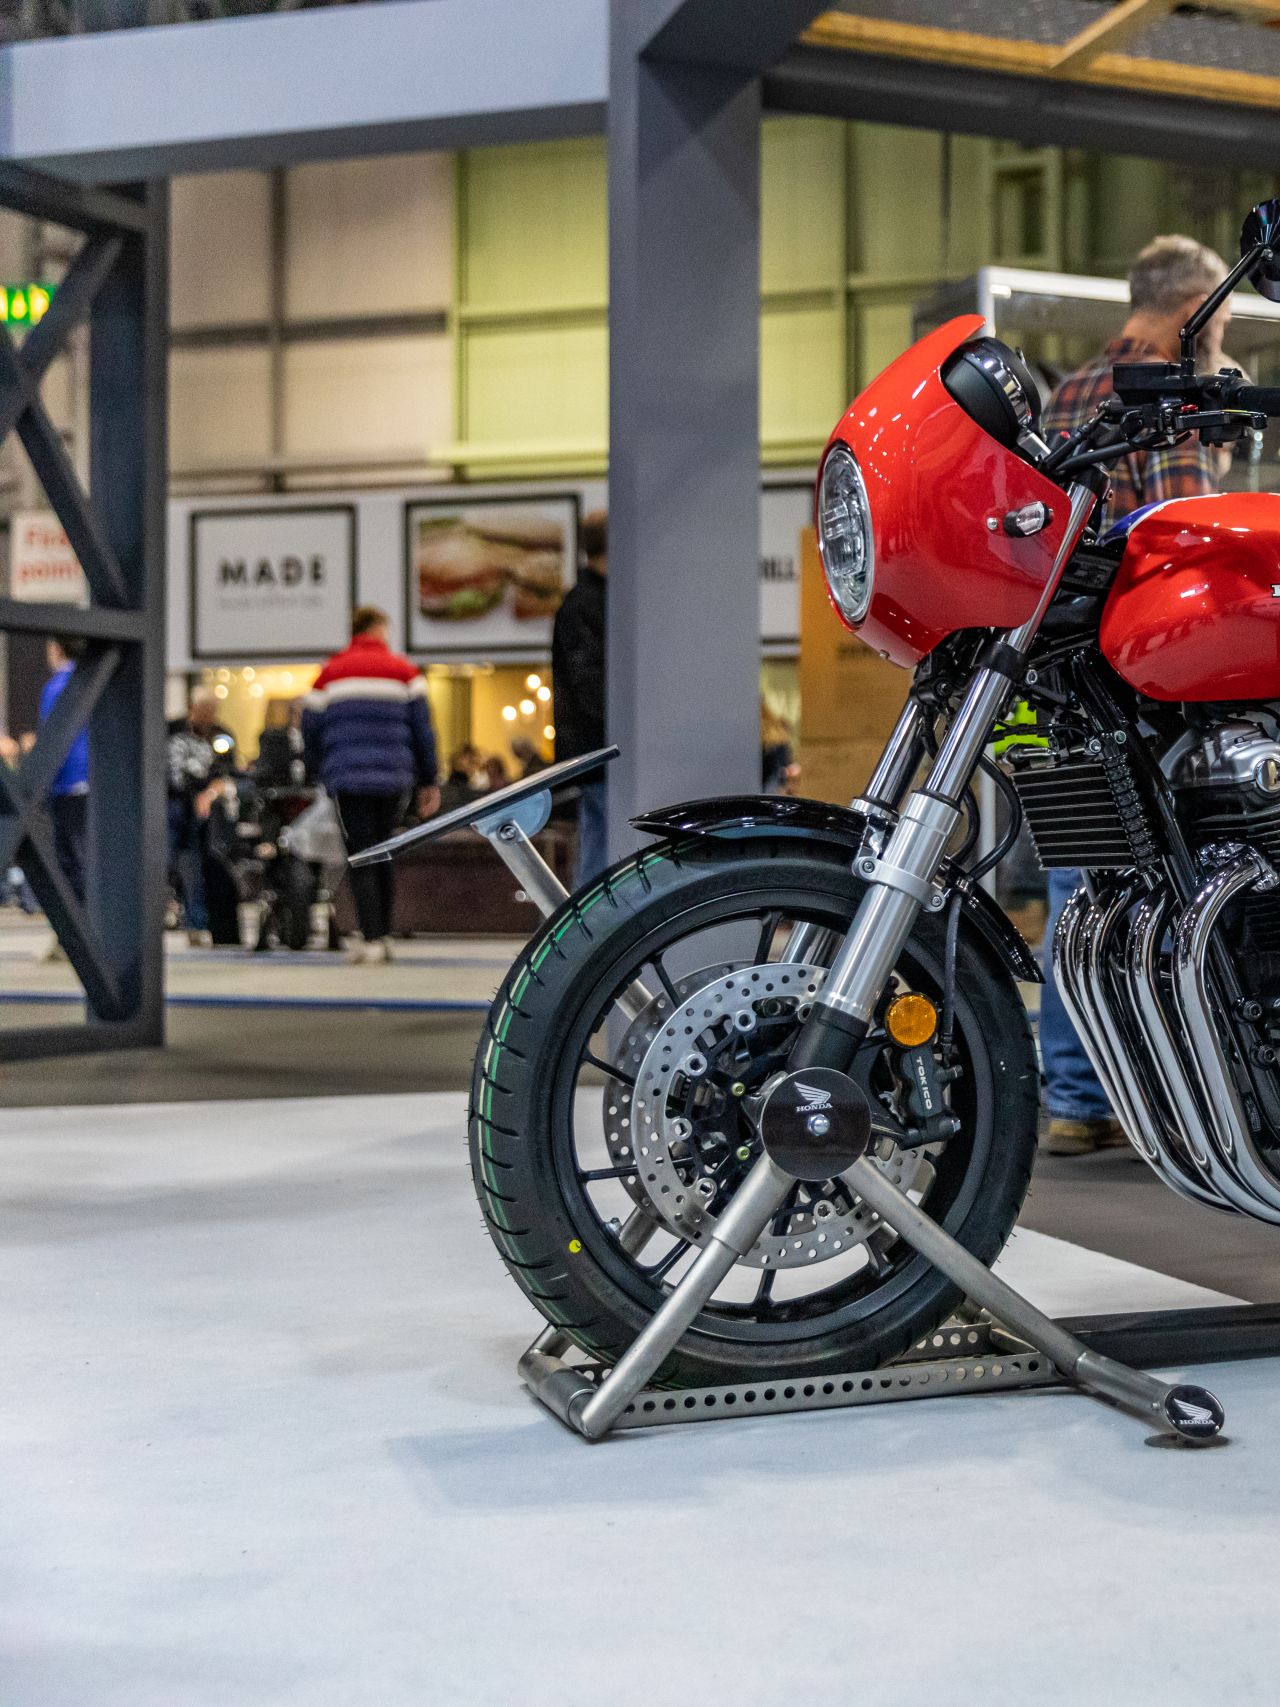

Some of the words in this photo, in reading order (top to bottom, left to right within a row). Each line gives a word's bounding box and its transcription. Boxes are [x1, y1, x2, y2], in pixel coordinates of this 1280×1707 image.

[217, 557, 325, 586] MADE
[915, 1055, 934, 1110] TOKICO
[796, 1102, 833, 1113] HONDA
